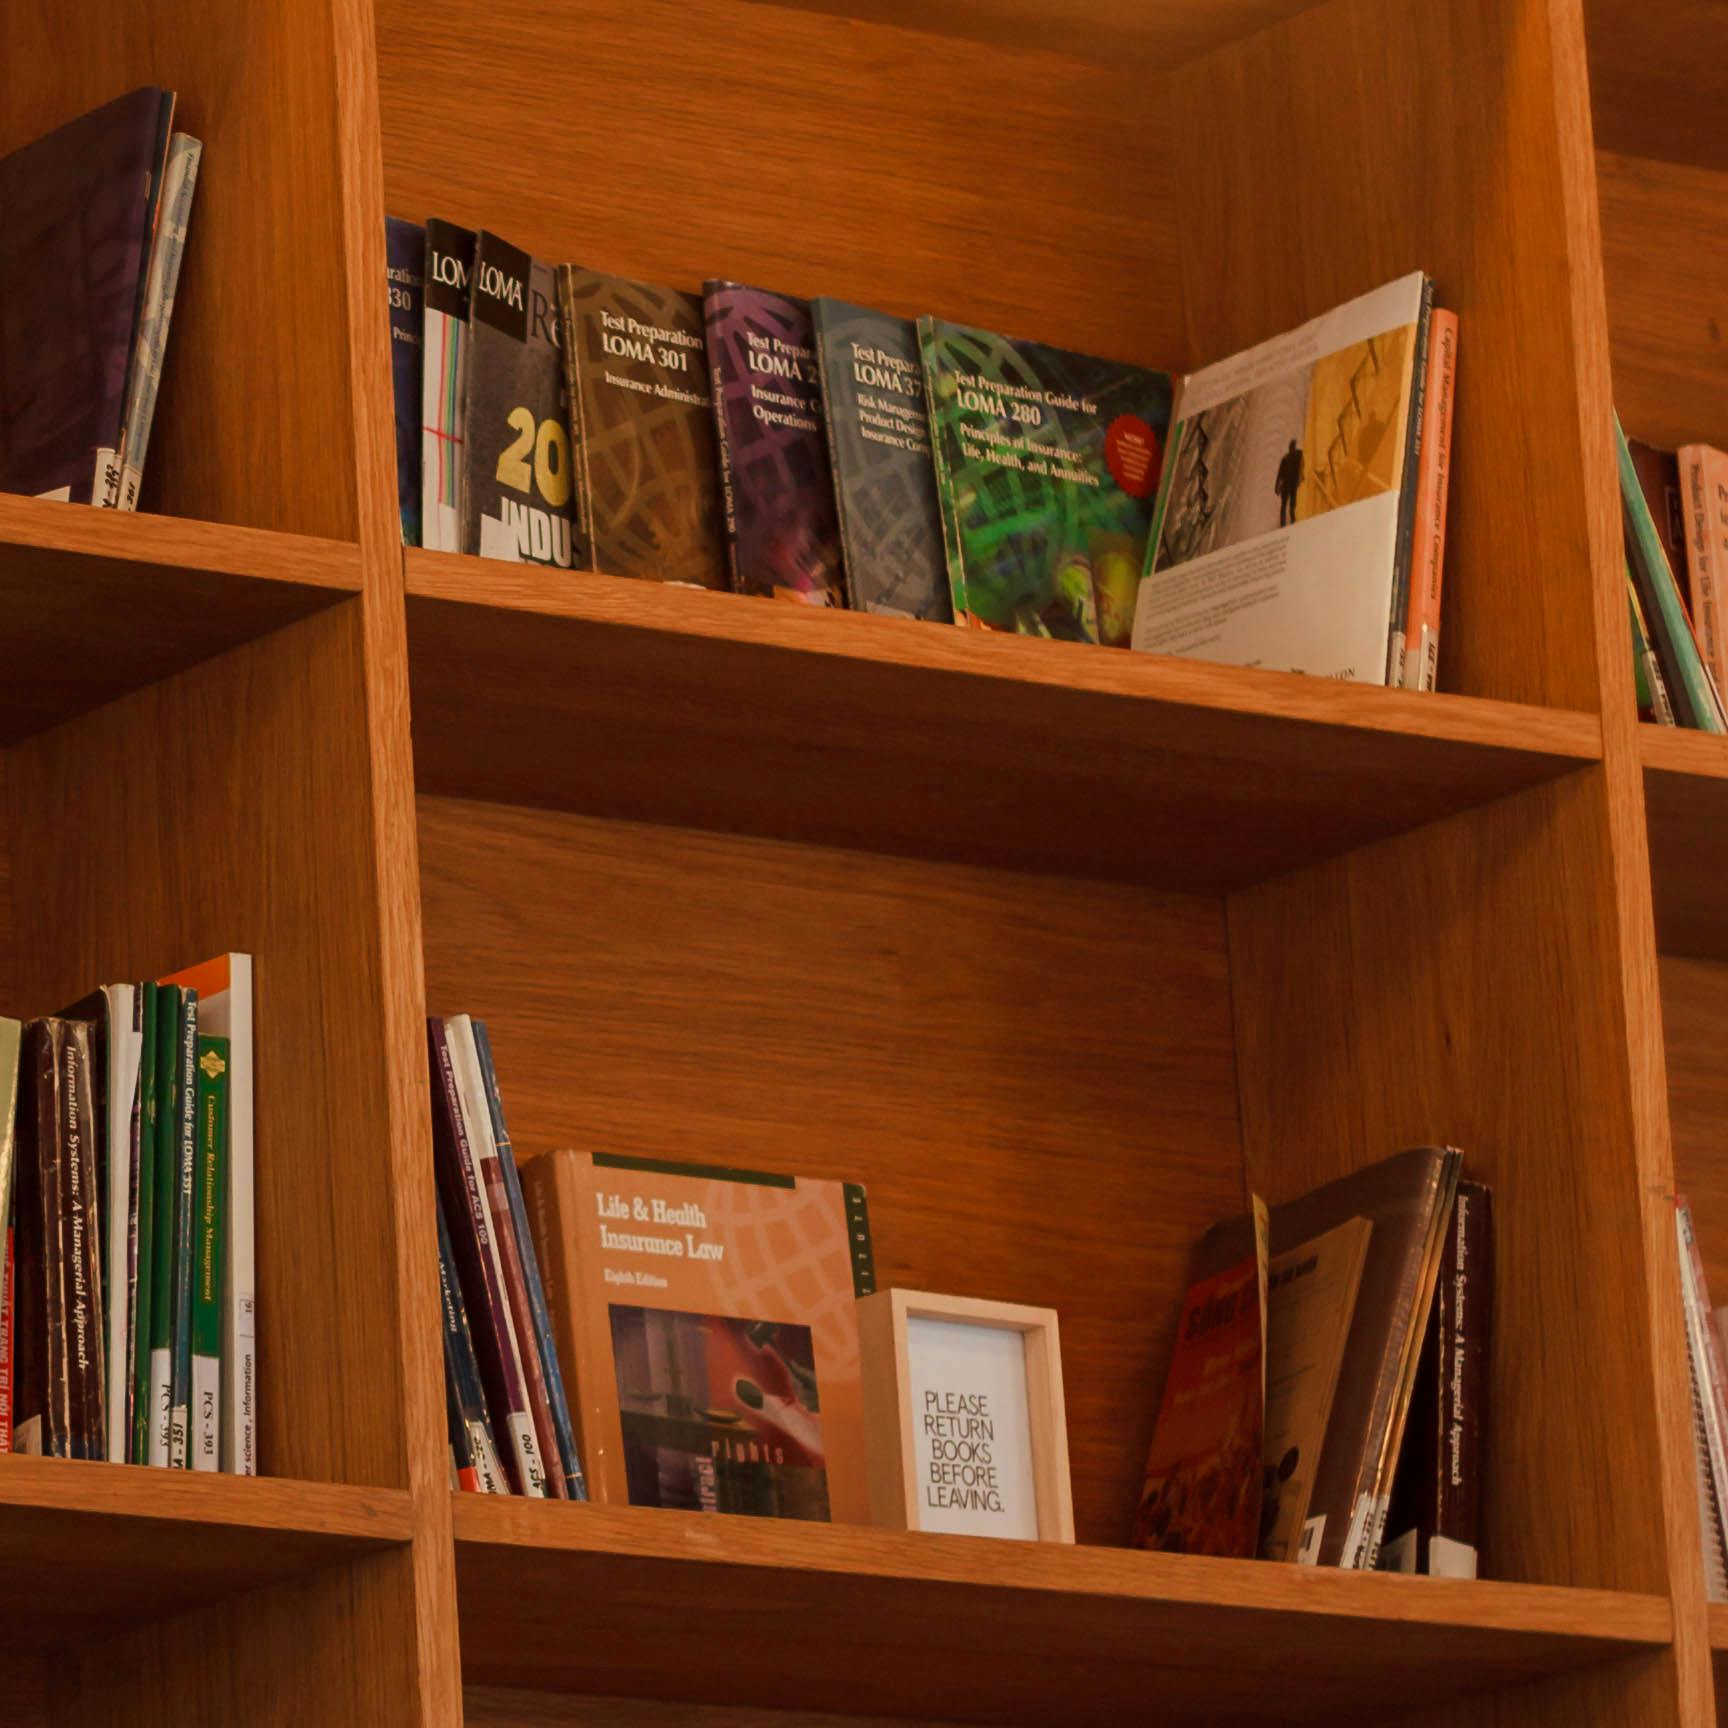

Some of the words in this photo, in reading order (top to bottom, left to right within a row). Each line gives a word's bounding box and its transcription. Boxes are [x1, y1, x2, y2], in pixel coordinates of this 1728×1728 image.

[478, 260, 524, 312] LOMA
[600, 310, 626, 331] Test
[628, 318, 704, 351] Preparation
[746, 331, 770, 349] Test
[603, 332, 656, 366] LOMA
[658, 348, 689, 372] 301
[850, 342, 876, 363] Test
[1441, 326, 1455, 371] Capital
[748, 350, 802, 382] LOMA
[853, 362, 903, 393] LOMA
[604, 371, 653, 395] Insurance
[751, 383, 807, 411] Insurance
[955, 370, 977, 390] Test
[978, 375, 1043, 403] Preparation
[1045, 390, 1080, 412] Guide
[1081, 396, 1098, 416] for
[857, 393, 877, 410] Risk
[957, 388, 1008, 420] LOMA
[1010, 401, 1041, 426] 280
[1437, 373, 1453, 451] Management
[859, 408, 891, 430] Product
[860, 425, 905, 450] Insurance
[960, 422, 1014, 449] Principles
[1015, 436, 1025, 449] of
[495, 406, 571, 508] 20
[962, 442, 985, 464] Life,
[986, 448, 1026, 472] Health,
[1027, 458, 1048, 475] and
[1050, 464, 1100, 487] Annuities
[186, 1000, 198, 1022] Test
[184, 1022, 197, 1084] Preparation
[439, 1043, 450, 1069] Test
[64, 1045, 78, 1129] Information
[184, 1086, 195, 1116] Guide
[444, 1069, 465, 1137] Preparation
[184, 1116, 194, 1129] for
[205, 1095, 217, 1150] Customer
[69, 1130, 81, 1199] Systems:
[458, 1137, 473, 1172] Guide
[205, 1151, 218, 1224] Relationship
[466, 1172, 476, 1191] for
[71, 1199, 81, 1211] A
[469, 1190, 484, 1220] ACS
[596, 1193, 630, 1221] Life
[633, 1198, 649, 1220] &
[651, 1199, 708, 1229] Health
[475, 1221, 488, 1245] 100
[600, 1224, 683, 1258] Insurance
[687, 1234, 725, 1262] Law
[1456, 1194, 1470, 1271] Information
[71, 1210, 87, 1296] Managerial
[204, 1225, 216, 1304] Management
[75, 1296, 90, 1371] Approach
[1454, 1334, 1465, 1344] A
[242, 1352, 253, 1416] Information
[1450, 1348, 1466, 1422] Managerial
[202, 1390, 216, 1418] PCS
[924, 1390, 990, 1417] PLEASE
[173, 1421, 186, 1446] 351
[923, 1414, 994, 1441] RETURN
[202, 1429, 215, 1458] 393
[711, 1438, 785, 1465] rights
[931, 1438, 993, 1464] BOOKS
[1449, 1422, 1463, 1486] Approach
[929, 1462, 999, 1489] BEFORE
[927, 1485, 1005, 1513] LEAVING.
